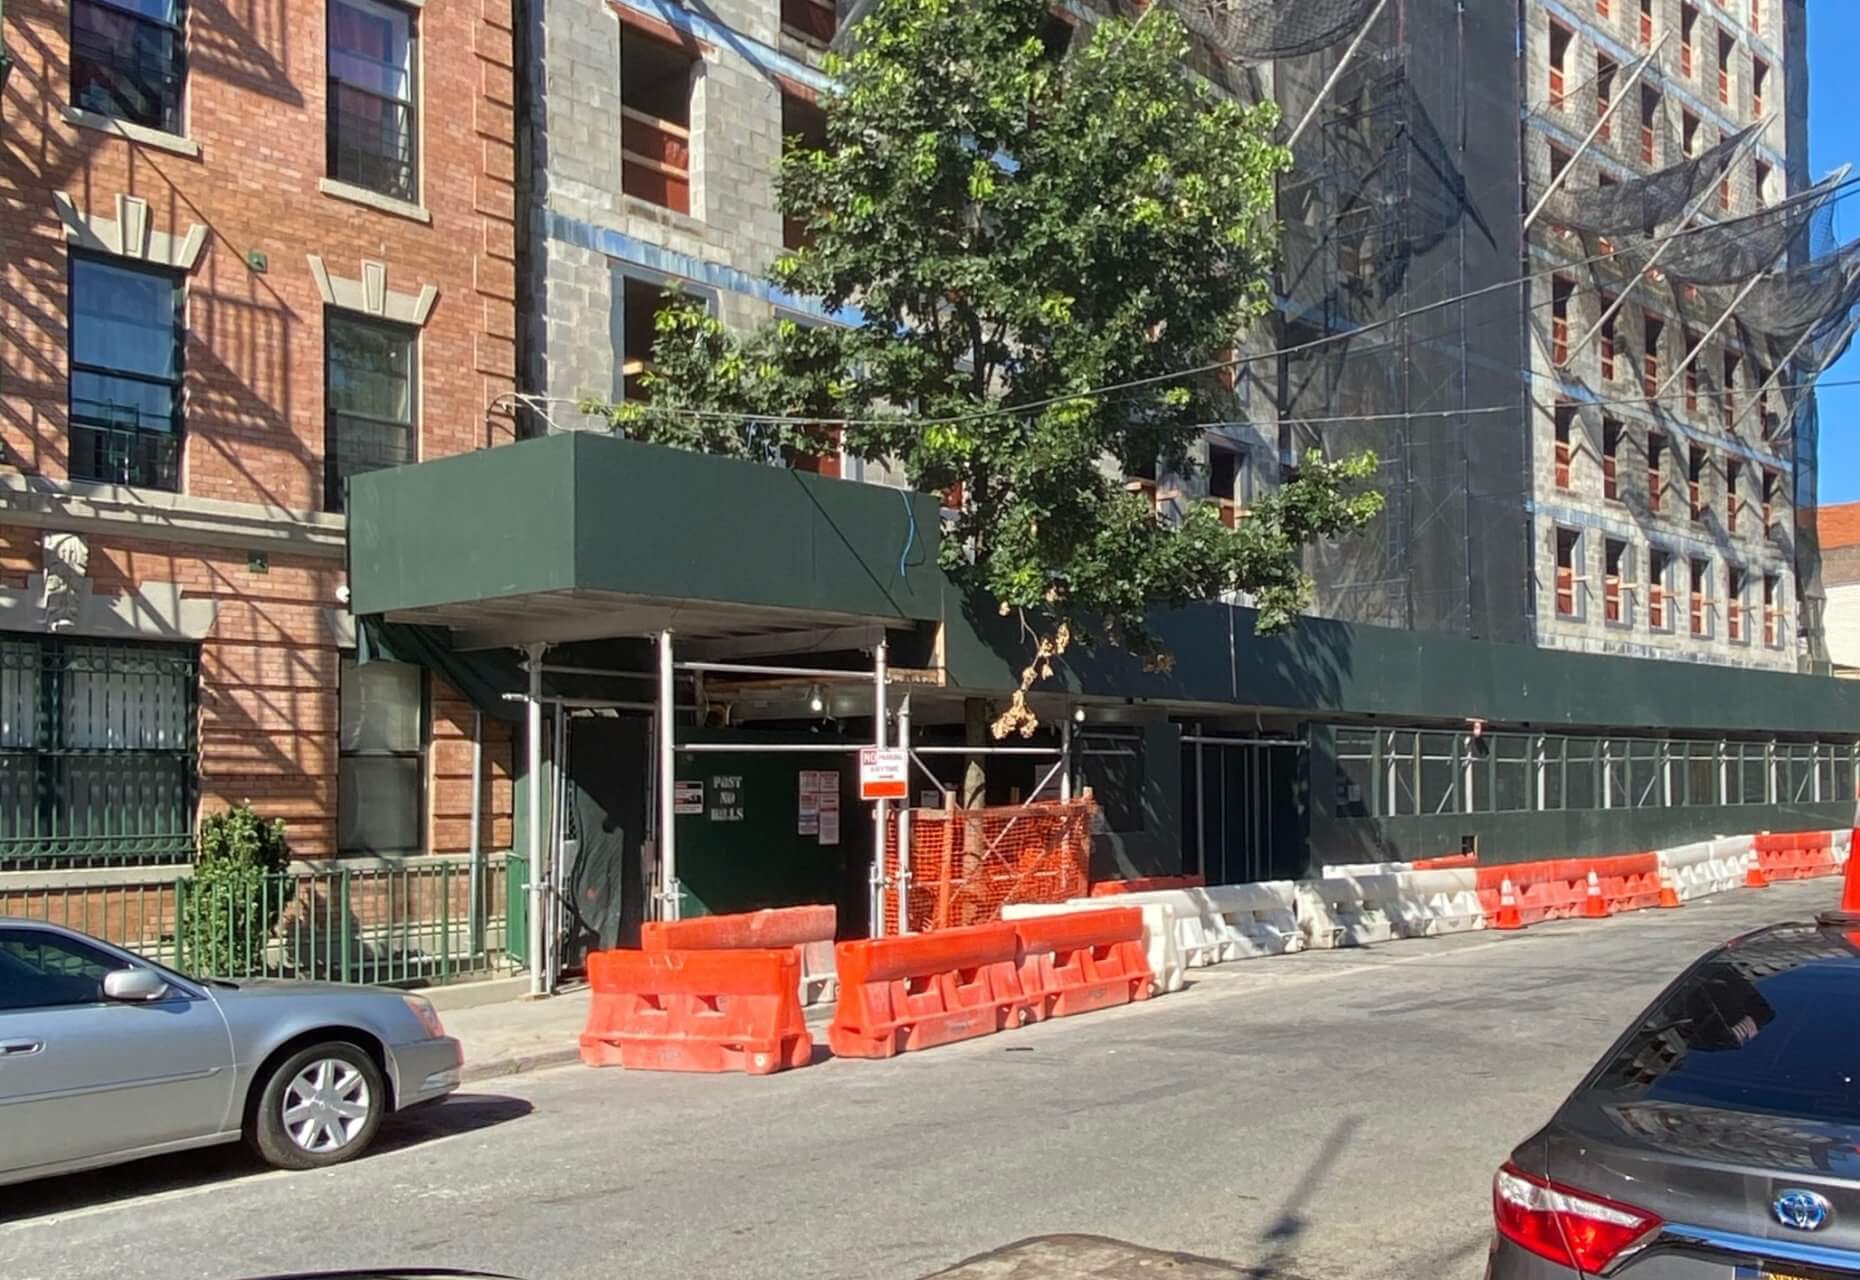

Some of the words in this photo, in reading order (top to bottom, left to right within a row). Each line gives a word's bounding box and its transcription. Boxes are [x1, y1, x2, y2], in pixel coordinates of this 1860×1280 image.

[713, 775, 743, 789] POST
[720, 791, 736, 804] NO
[711, 807, 744, 821] BILLS
